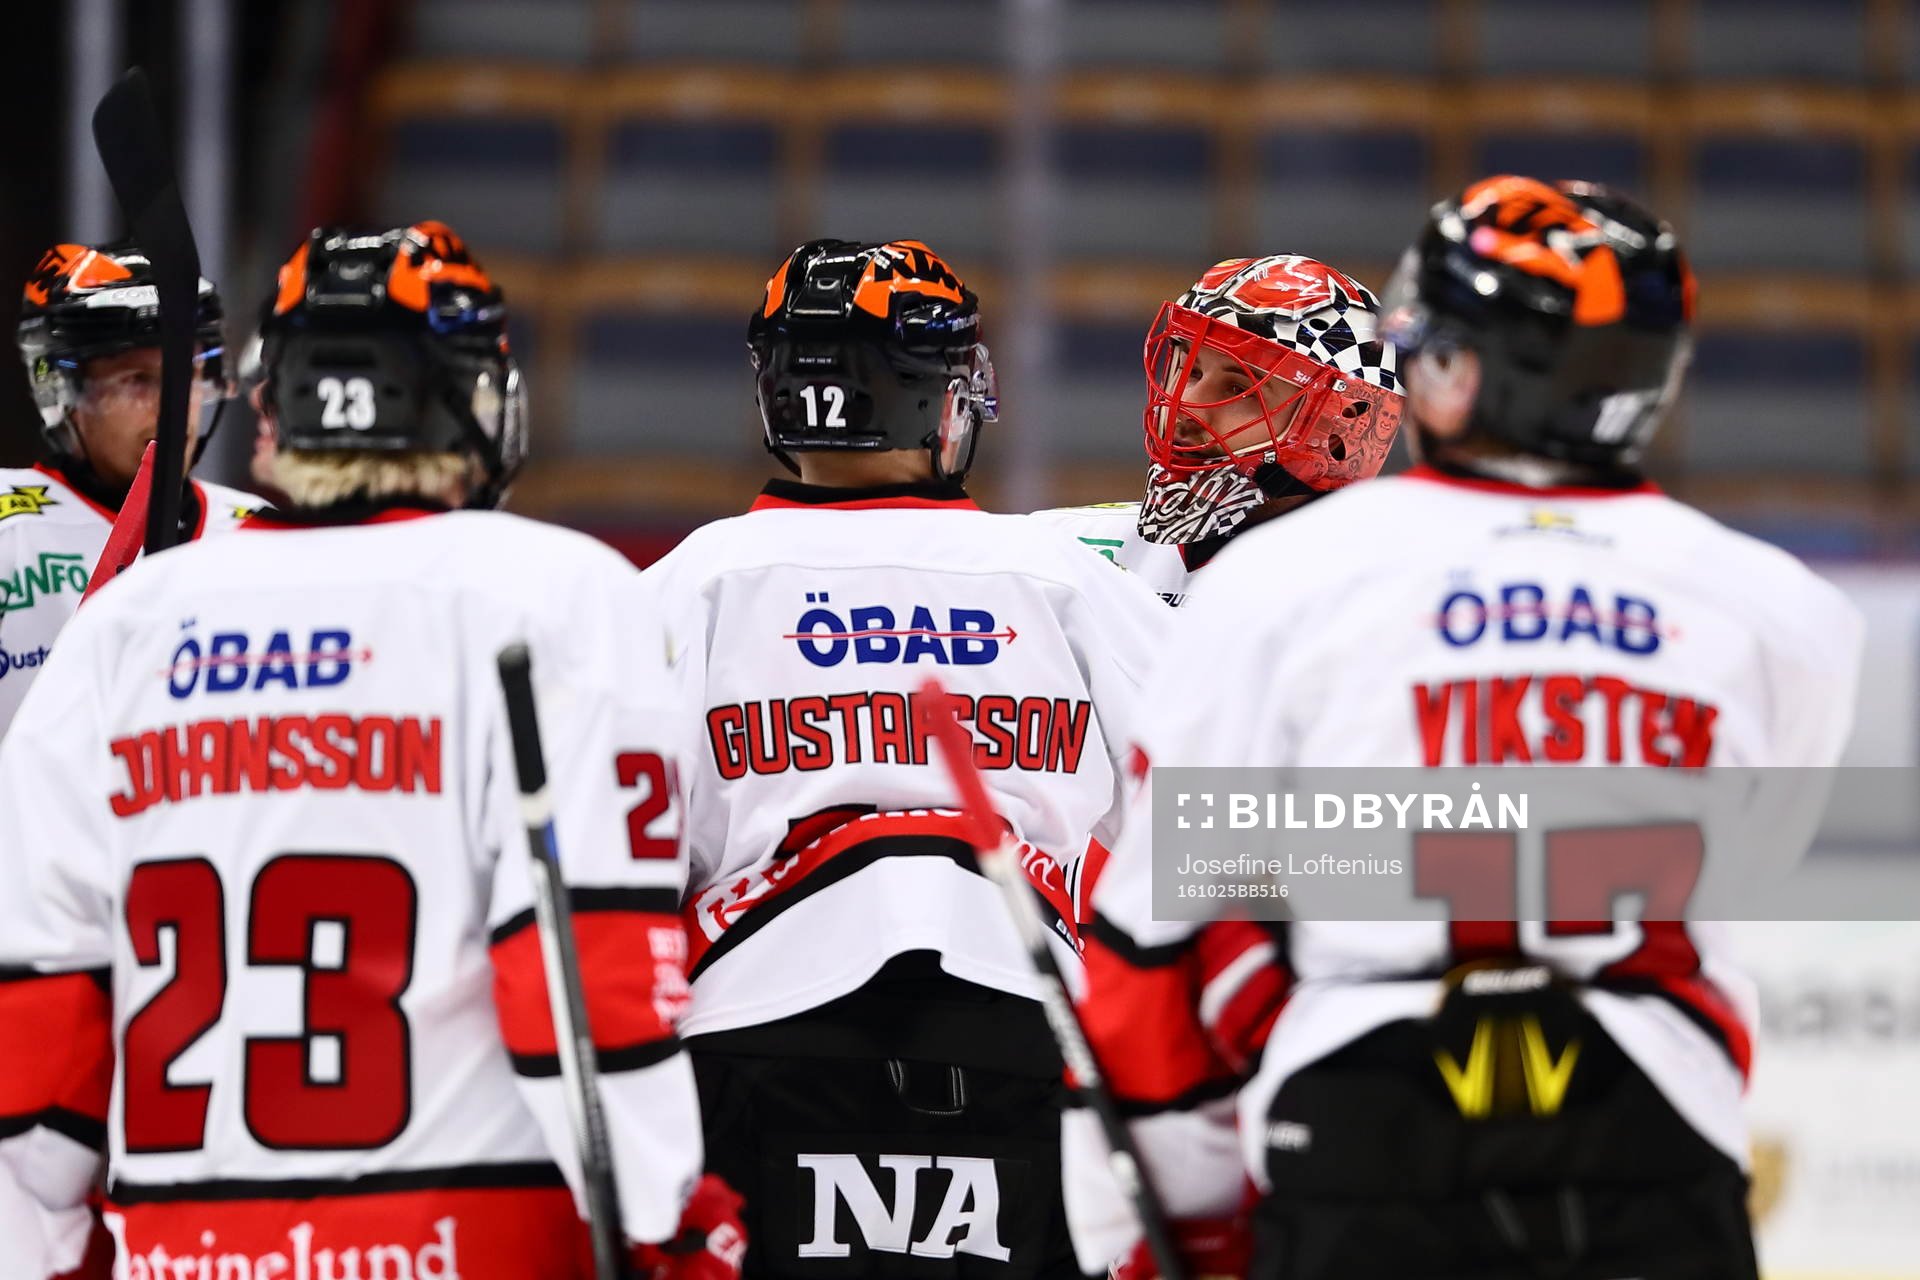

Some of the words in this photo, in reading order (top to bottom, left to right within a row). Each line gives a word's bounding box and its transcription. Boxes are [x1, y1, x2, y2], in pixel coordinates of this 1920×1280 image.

[317, 378, 376, 429] 23
[799, 385, 846, 428] 12
[168, 617, 353, 699] ÖBAB
[796, 592, 999, 667] ÖBAB
[1437, 569, 1662, 656] ÖBAB
[109, 714, 443, 818] JOHANSSON
[1410, 672, 1719, 770] VIKSTEN
[1412, 821, 1707, 978] 17
[122, 852, 418, 1155] 23
[797, 1152, 1012, 1263] NA
